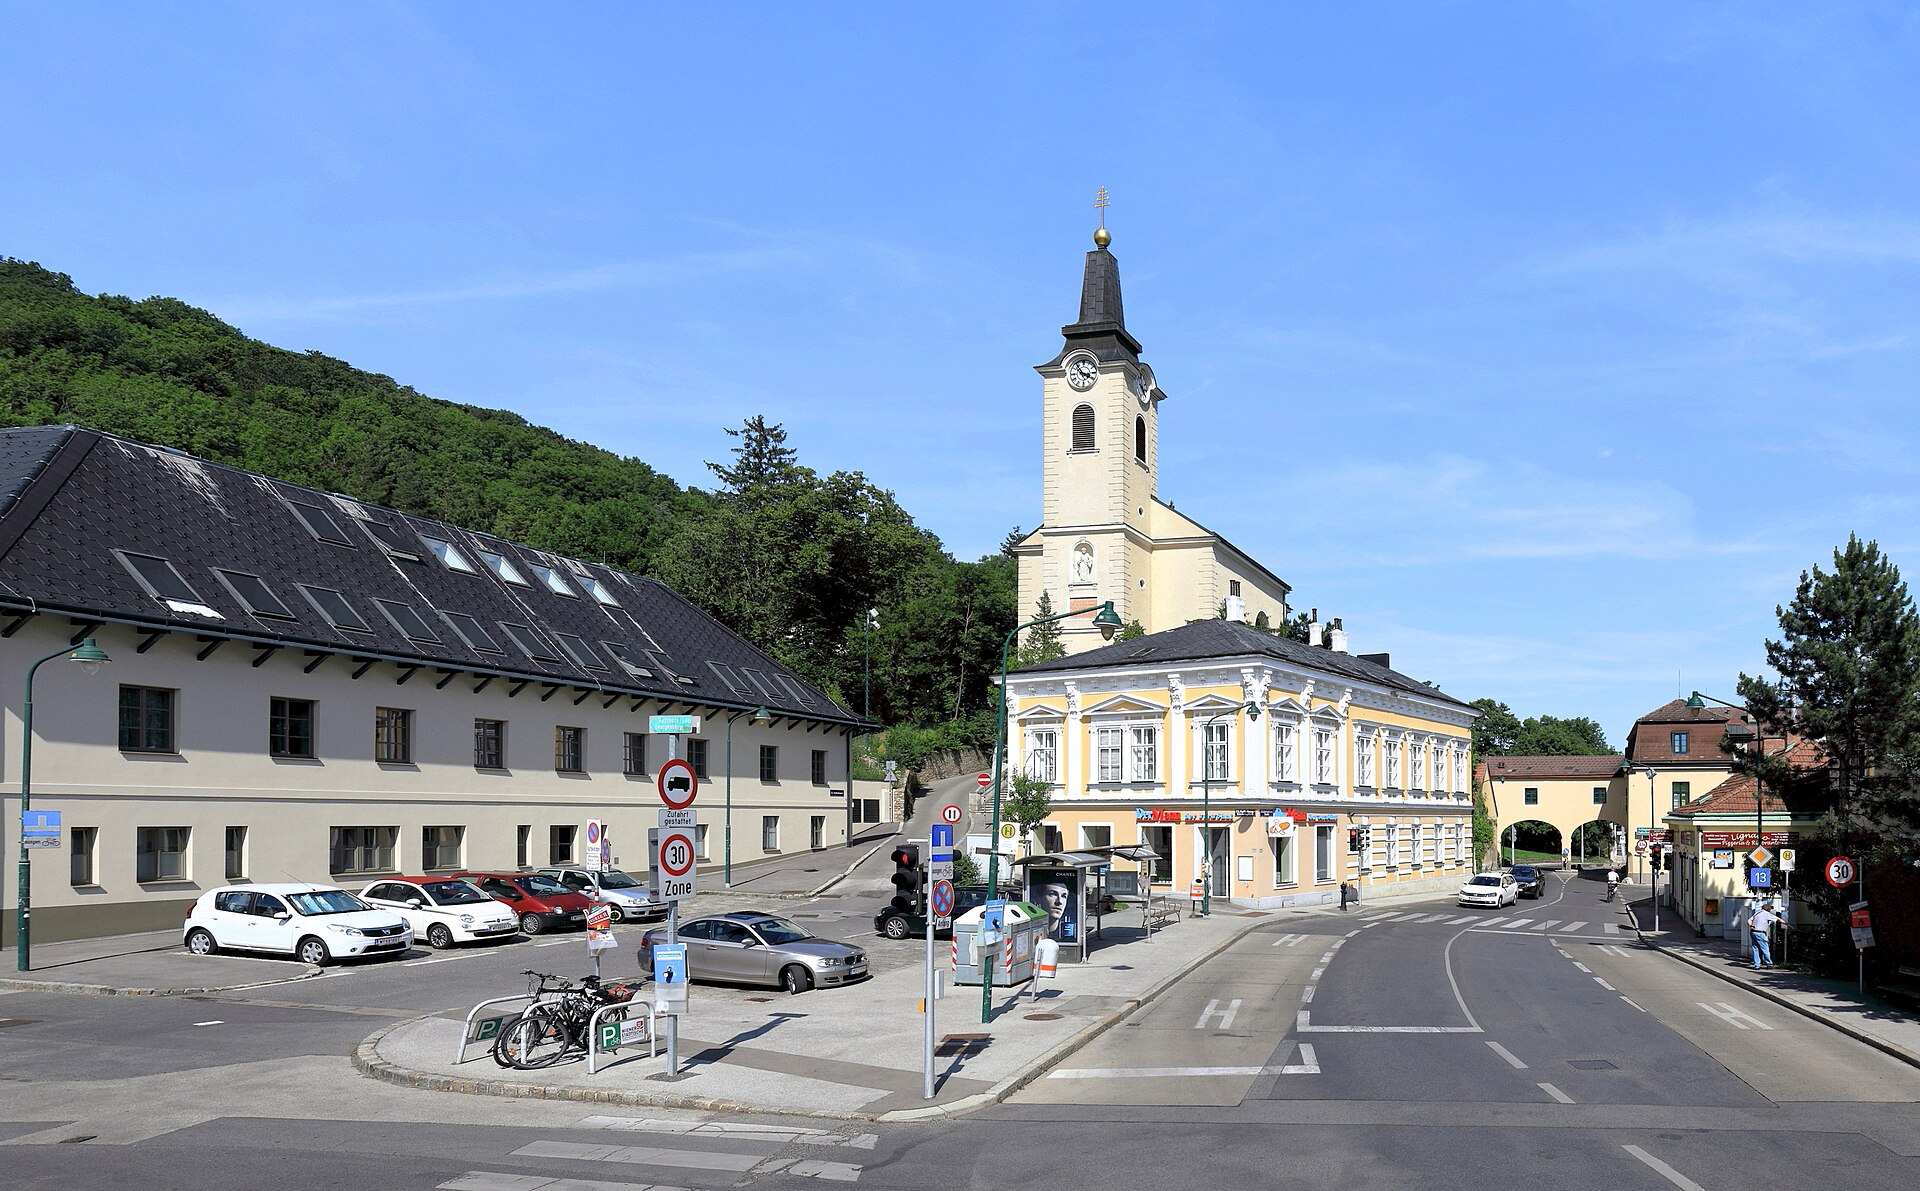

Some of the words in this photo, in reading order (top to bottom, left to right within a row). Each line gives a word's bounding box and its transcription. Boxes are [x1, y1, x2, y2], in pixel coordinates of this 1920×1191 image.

[664, 818, 691, 826] gestattet
[1004, 826, 1012, 836] H
[670, 846, 685, 865] 30
[1755, 872, 1767, 883] 13
[1834, 864, 1849, 879] 30
[665, 880, 692, 897] Zone
[477, 1020, 497, 1040] P
[602, 1026, 617, 1047] P
